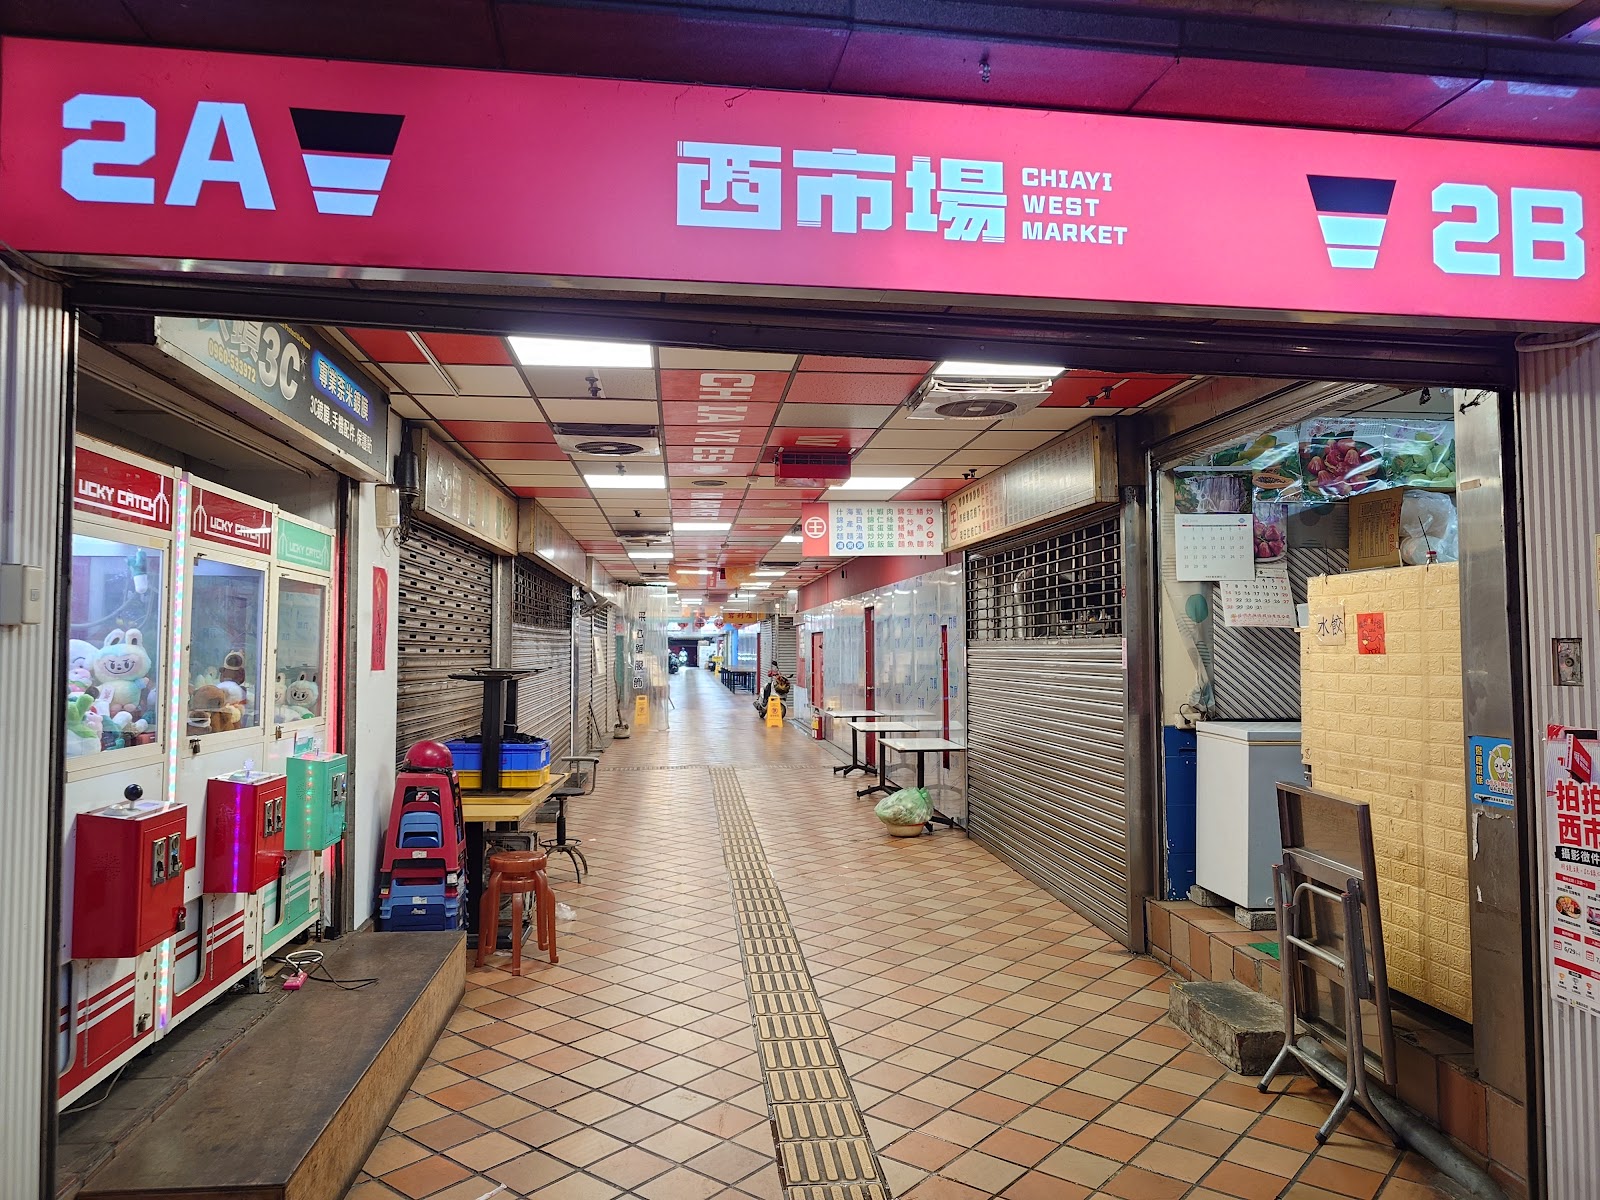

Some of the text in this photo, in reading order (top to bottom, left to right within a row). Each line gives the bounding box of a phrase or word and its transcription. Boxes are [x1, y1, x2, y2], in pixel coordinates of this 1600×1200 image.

[61, 93, 276, 211] 2A
[676, 141, 1007, 243] 西市場
[1021, 167, 1113, 191] CHIAYI
[1022, 194, 1100, 217] WEST
[1022, 221, 1128, 245] MARKET
[1431, 182, 1586, 280] 2B
[208, 337, 257, 384] 0960-533972
[318, 358, 369, 421] 專業奈米鍍膜
[694, 373, 756, 443] CHIAYI
[117, 487, 157, 513] CATCH
[306, 547, 323, 559] CATCH
[1317, 614, 1344, 637] 水餃
[1556, 780, 1600, 816] 拍拍
[1558, 812, 1600, 850] 西市
